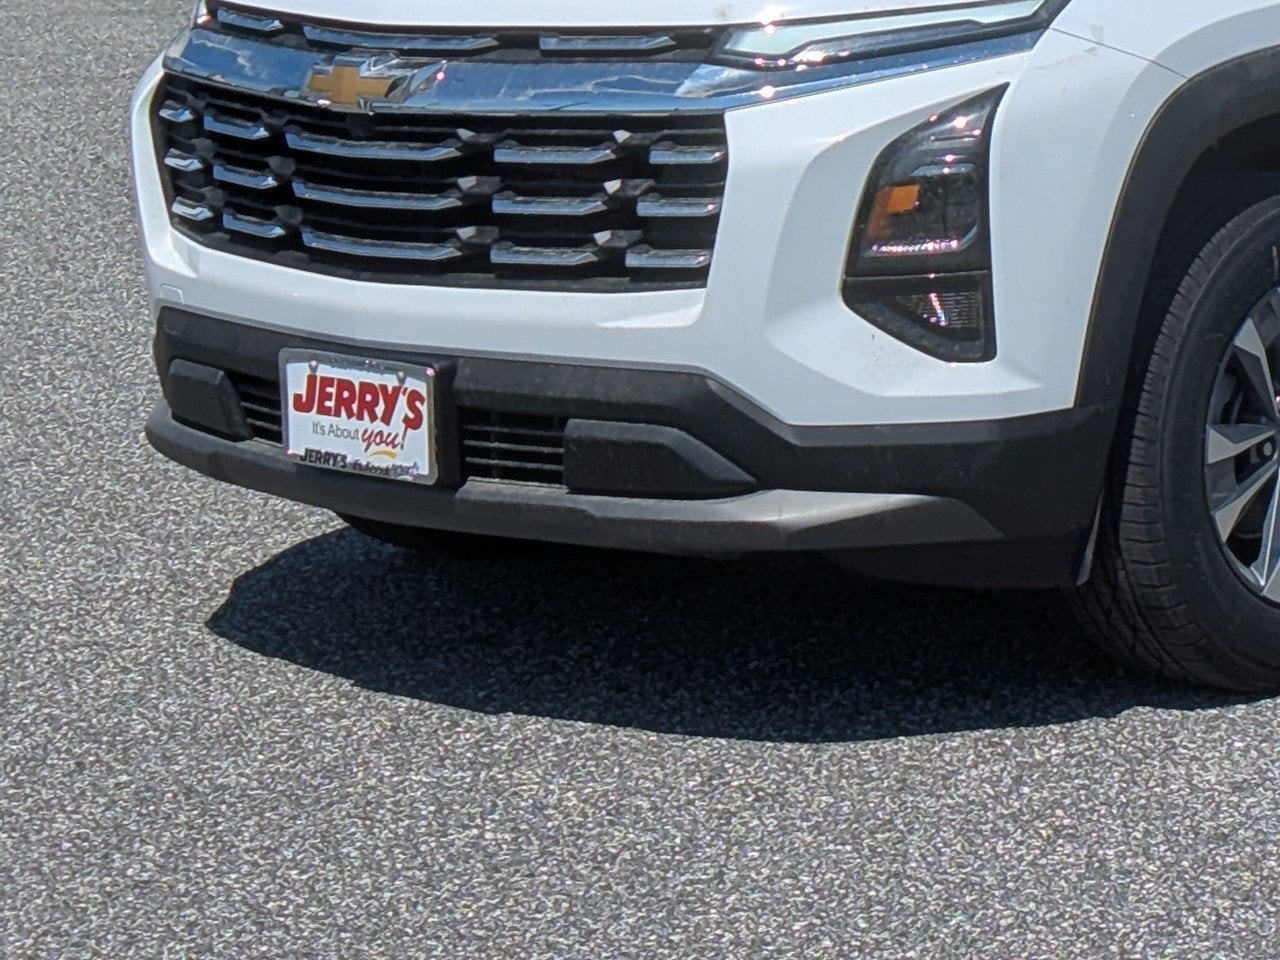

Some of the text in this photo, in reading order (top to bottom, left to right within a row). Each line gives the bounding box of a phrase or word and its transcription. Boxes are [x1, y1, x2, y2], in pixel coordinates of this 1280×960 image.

[292, 374, 426, 431] JERRY'S
[312, 421, 409, 452] It's About you!
